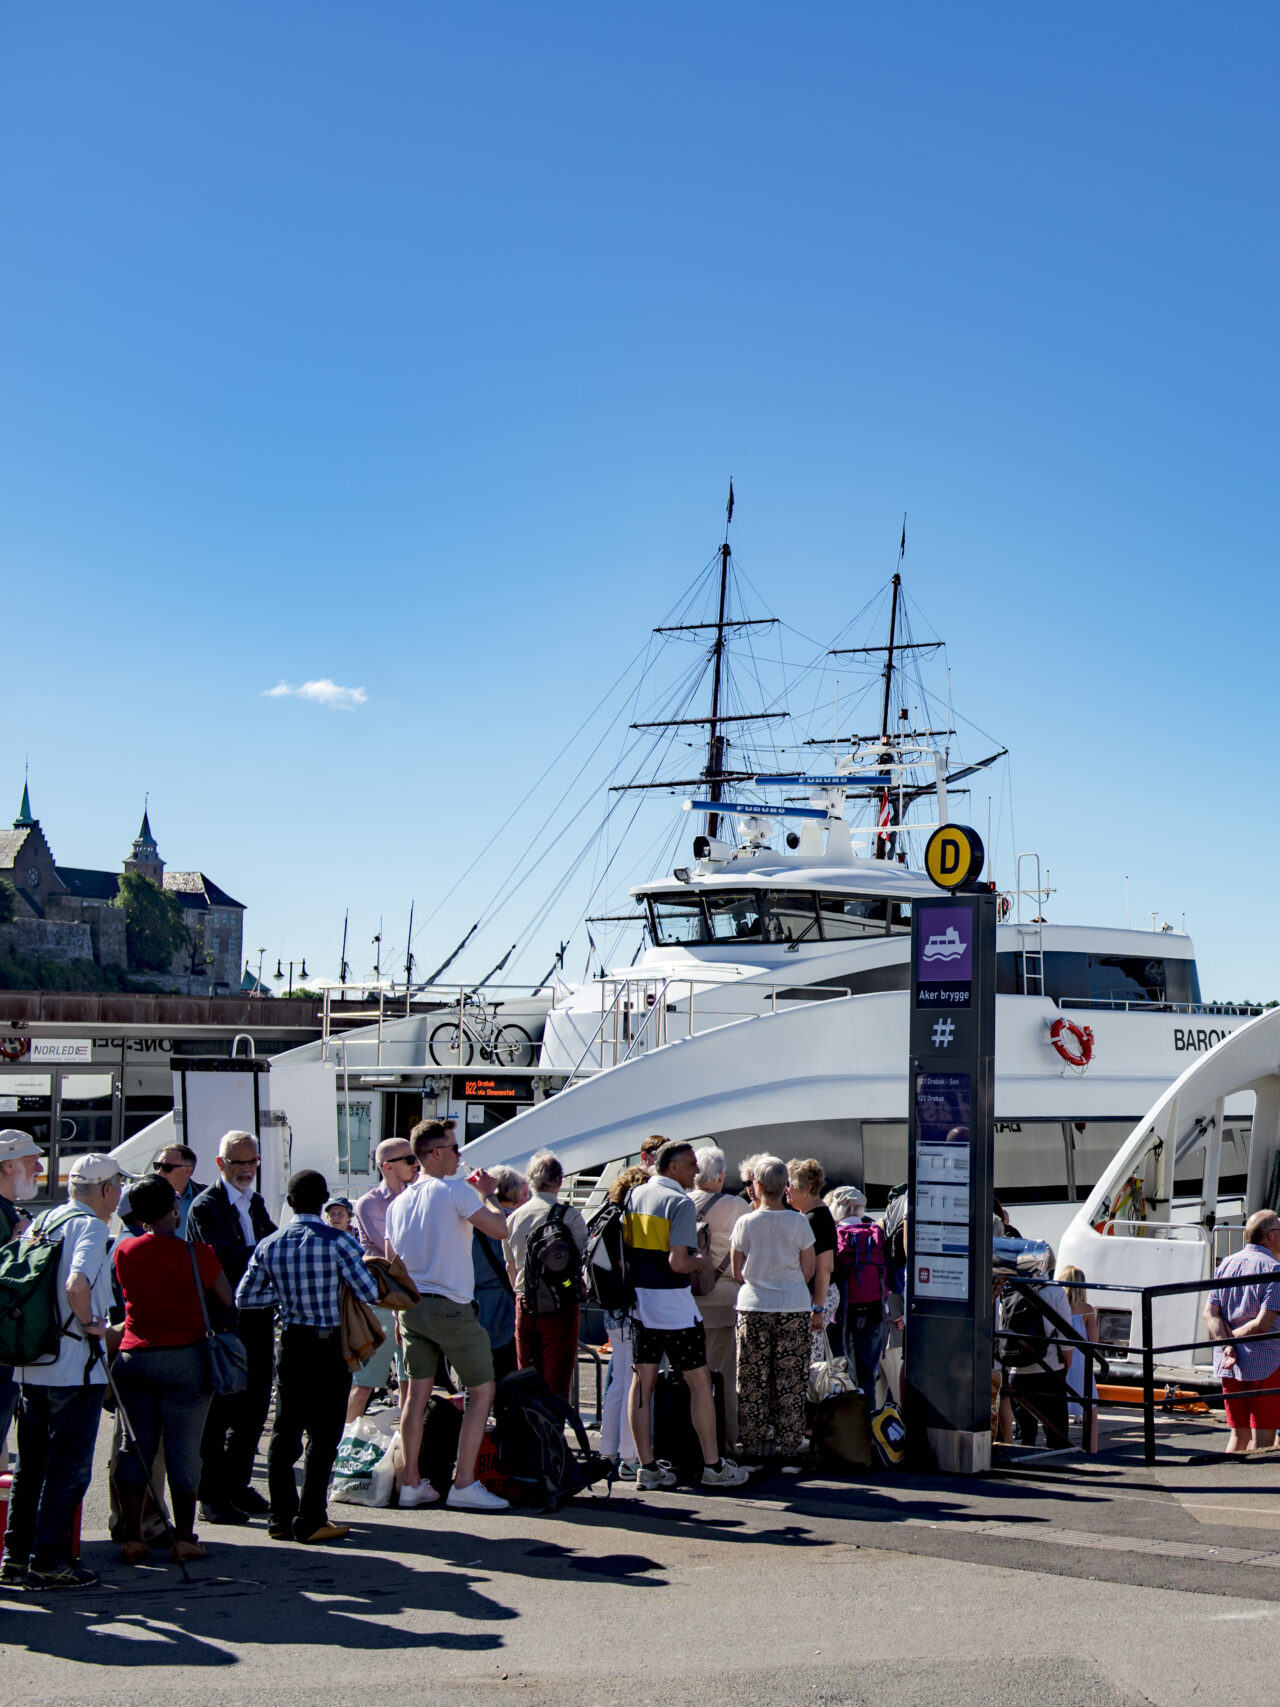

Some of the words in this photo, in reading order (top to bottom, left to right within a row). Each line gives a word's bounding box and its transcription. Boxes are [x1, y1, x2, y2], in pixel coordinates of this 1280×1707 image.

[798, 776, 848, 784] FURUNO
[736, 805, 786, 814] FURUNO
[940, 839, 960, 875] D
[919, 989, 939, 1000] Aker
[940, 989, 970, 1002] brygge
[33, 1045, 76, 1056] NORLED
[465, 1081, 477, 1095] B22
